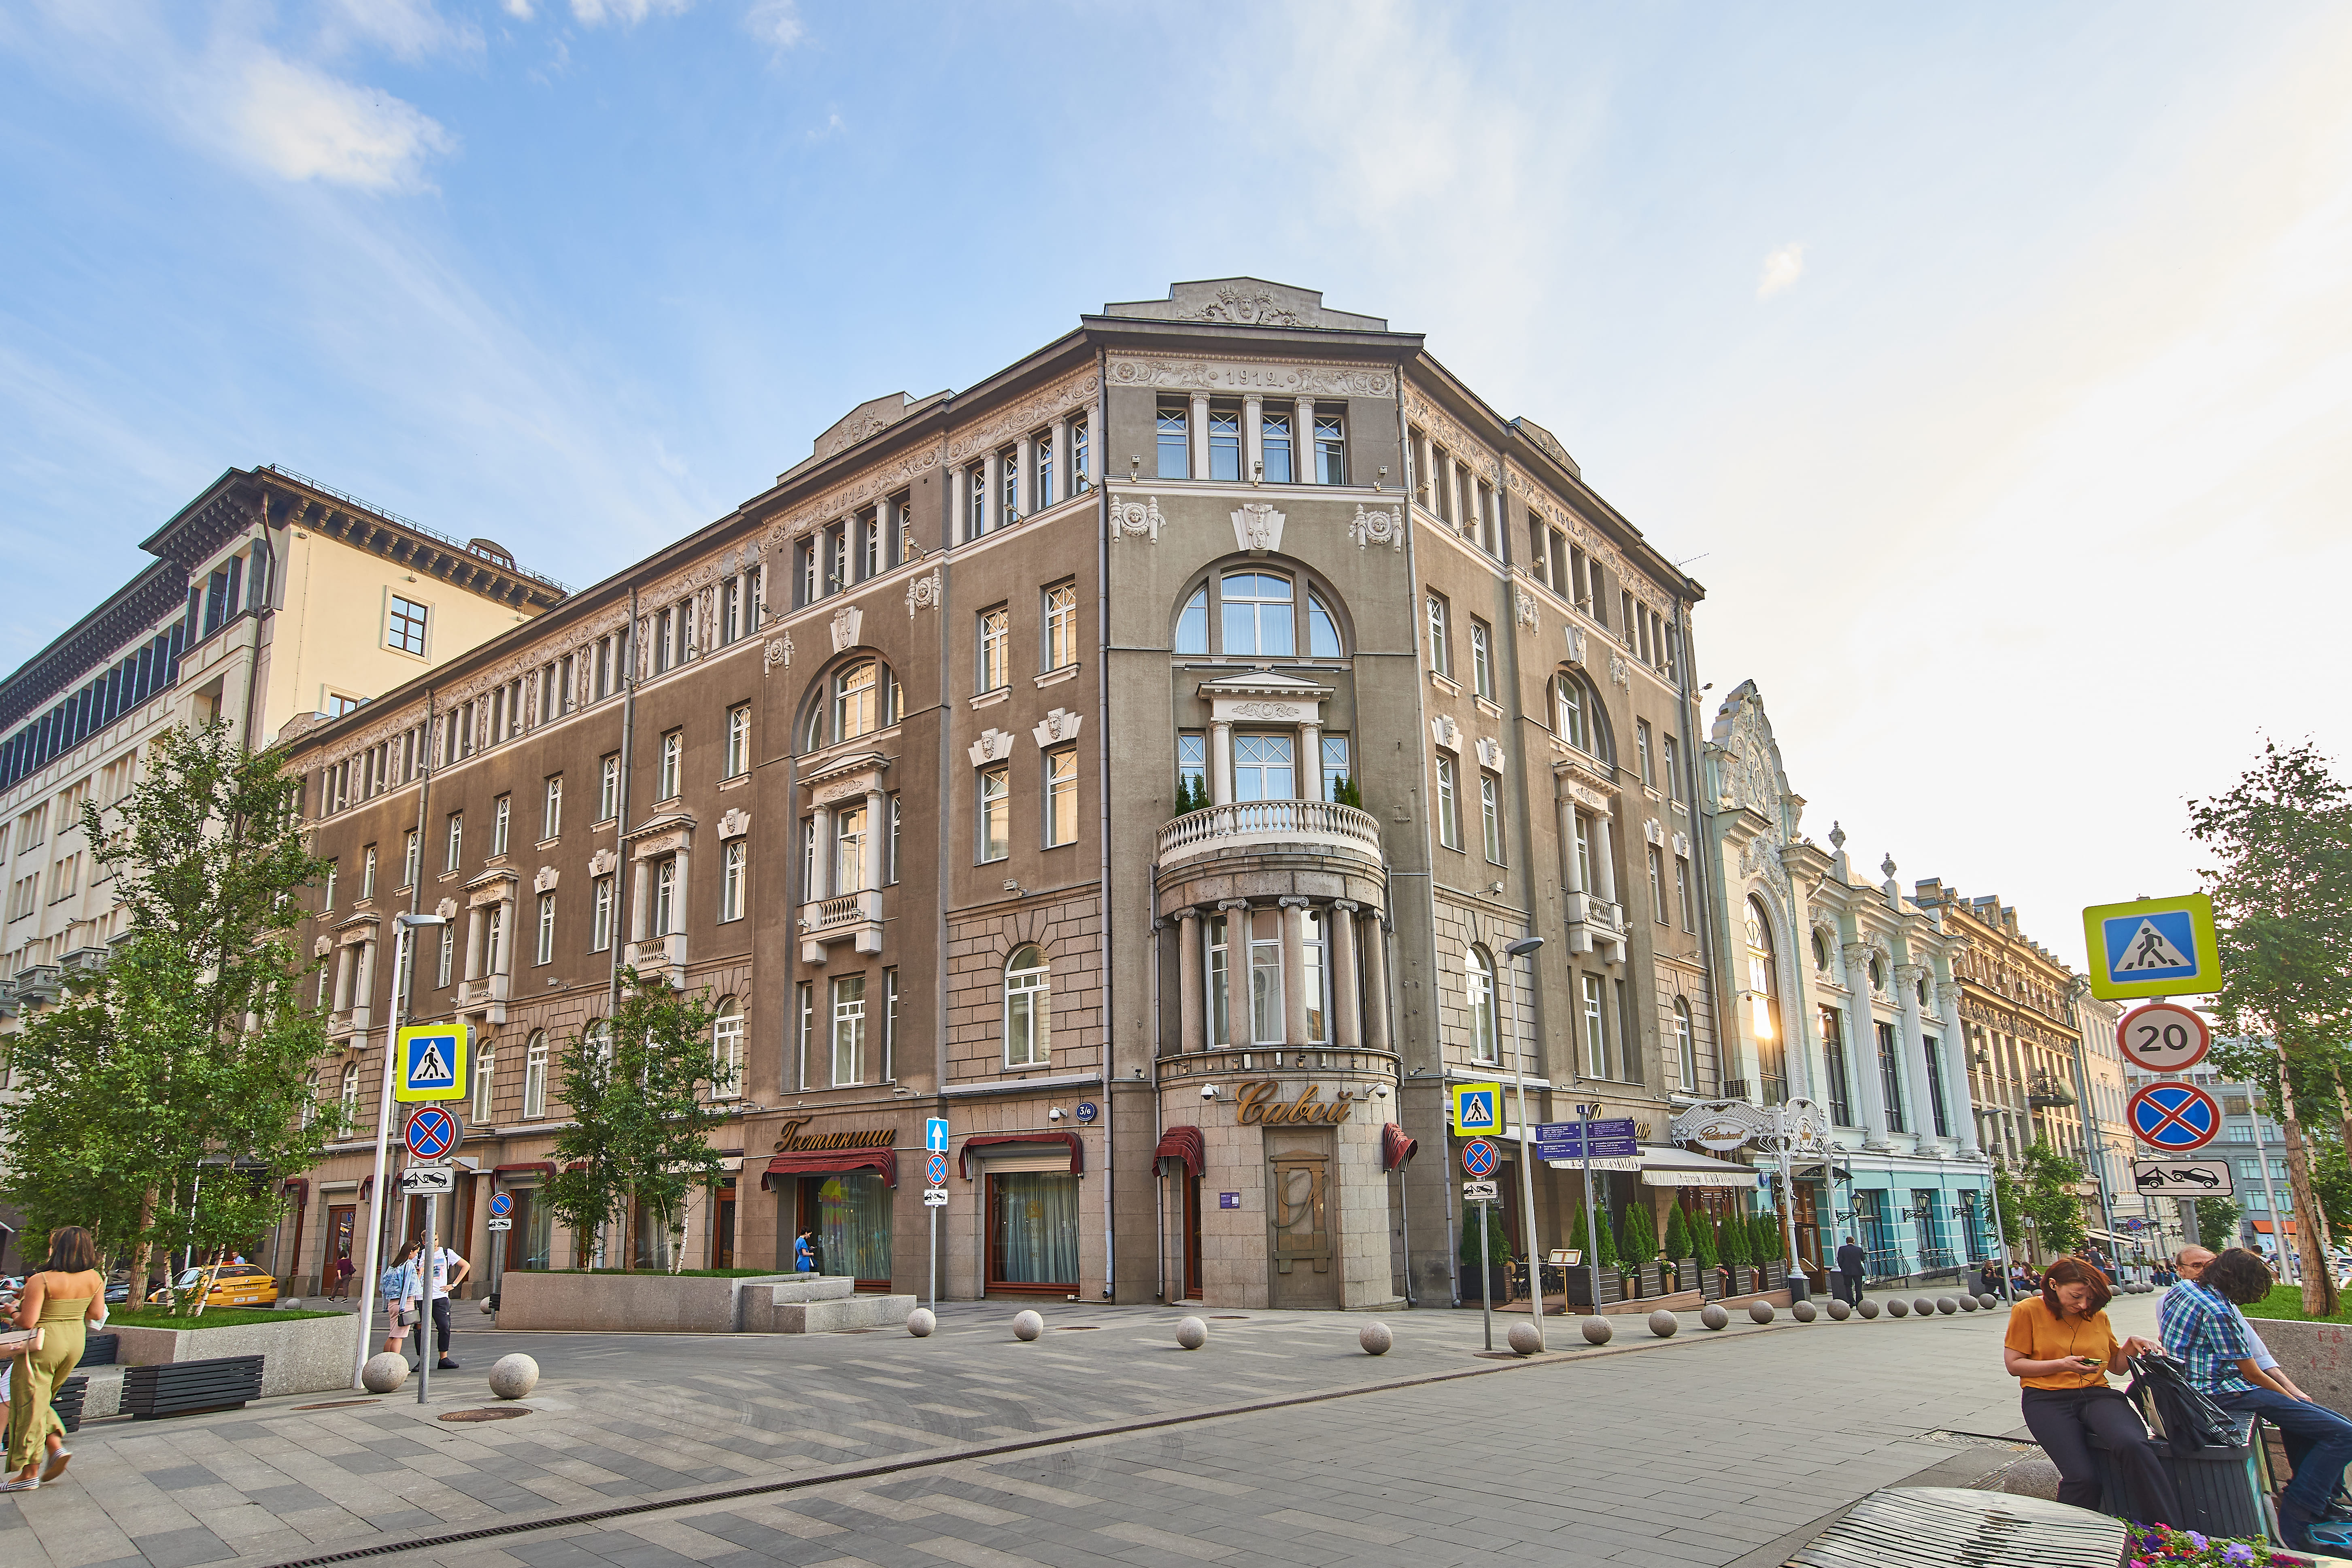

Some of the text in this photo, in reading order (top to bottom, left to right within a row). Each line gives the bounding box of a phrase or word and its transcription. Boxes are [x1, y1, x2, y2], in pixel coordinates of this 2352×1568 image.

[2137, 1024, 2188, 1052] 20
[1080, 1106, 1091, 1115] 3/6
[1235, 1081, 1353, 1124] Савой
[773, 1116, 896, 1151] Гостиница
[1698, 1126, 1745, 1141] Restaurant
